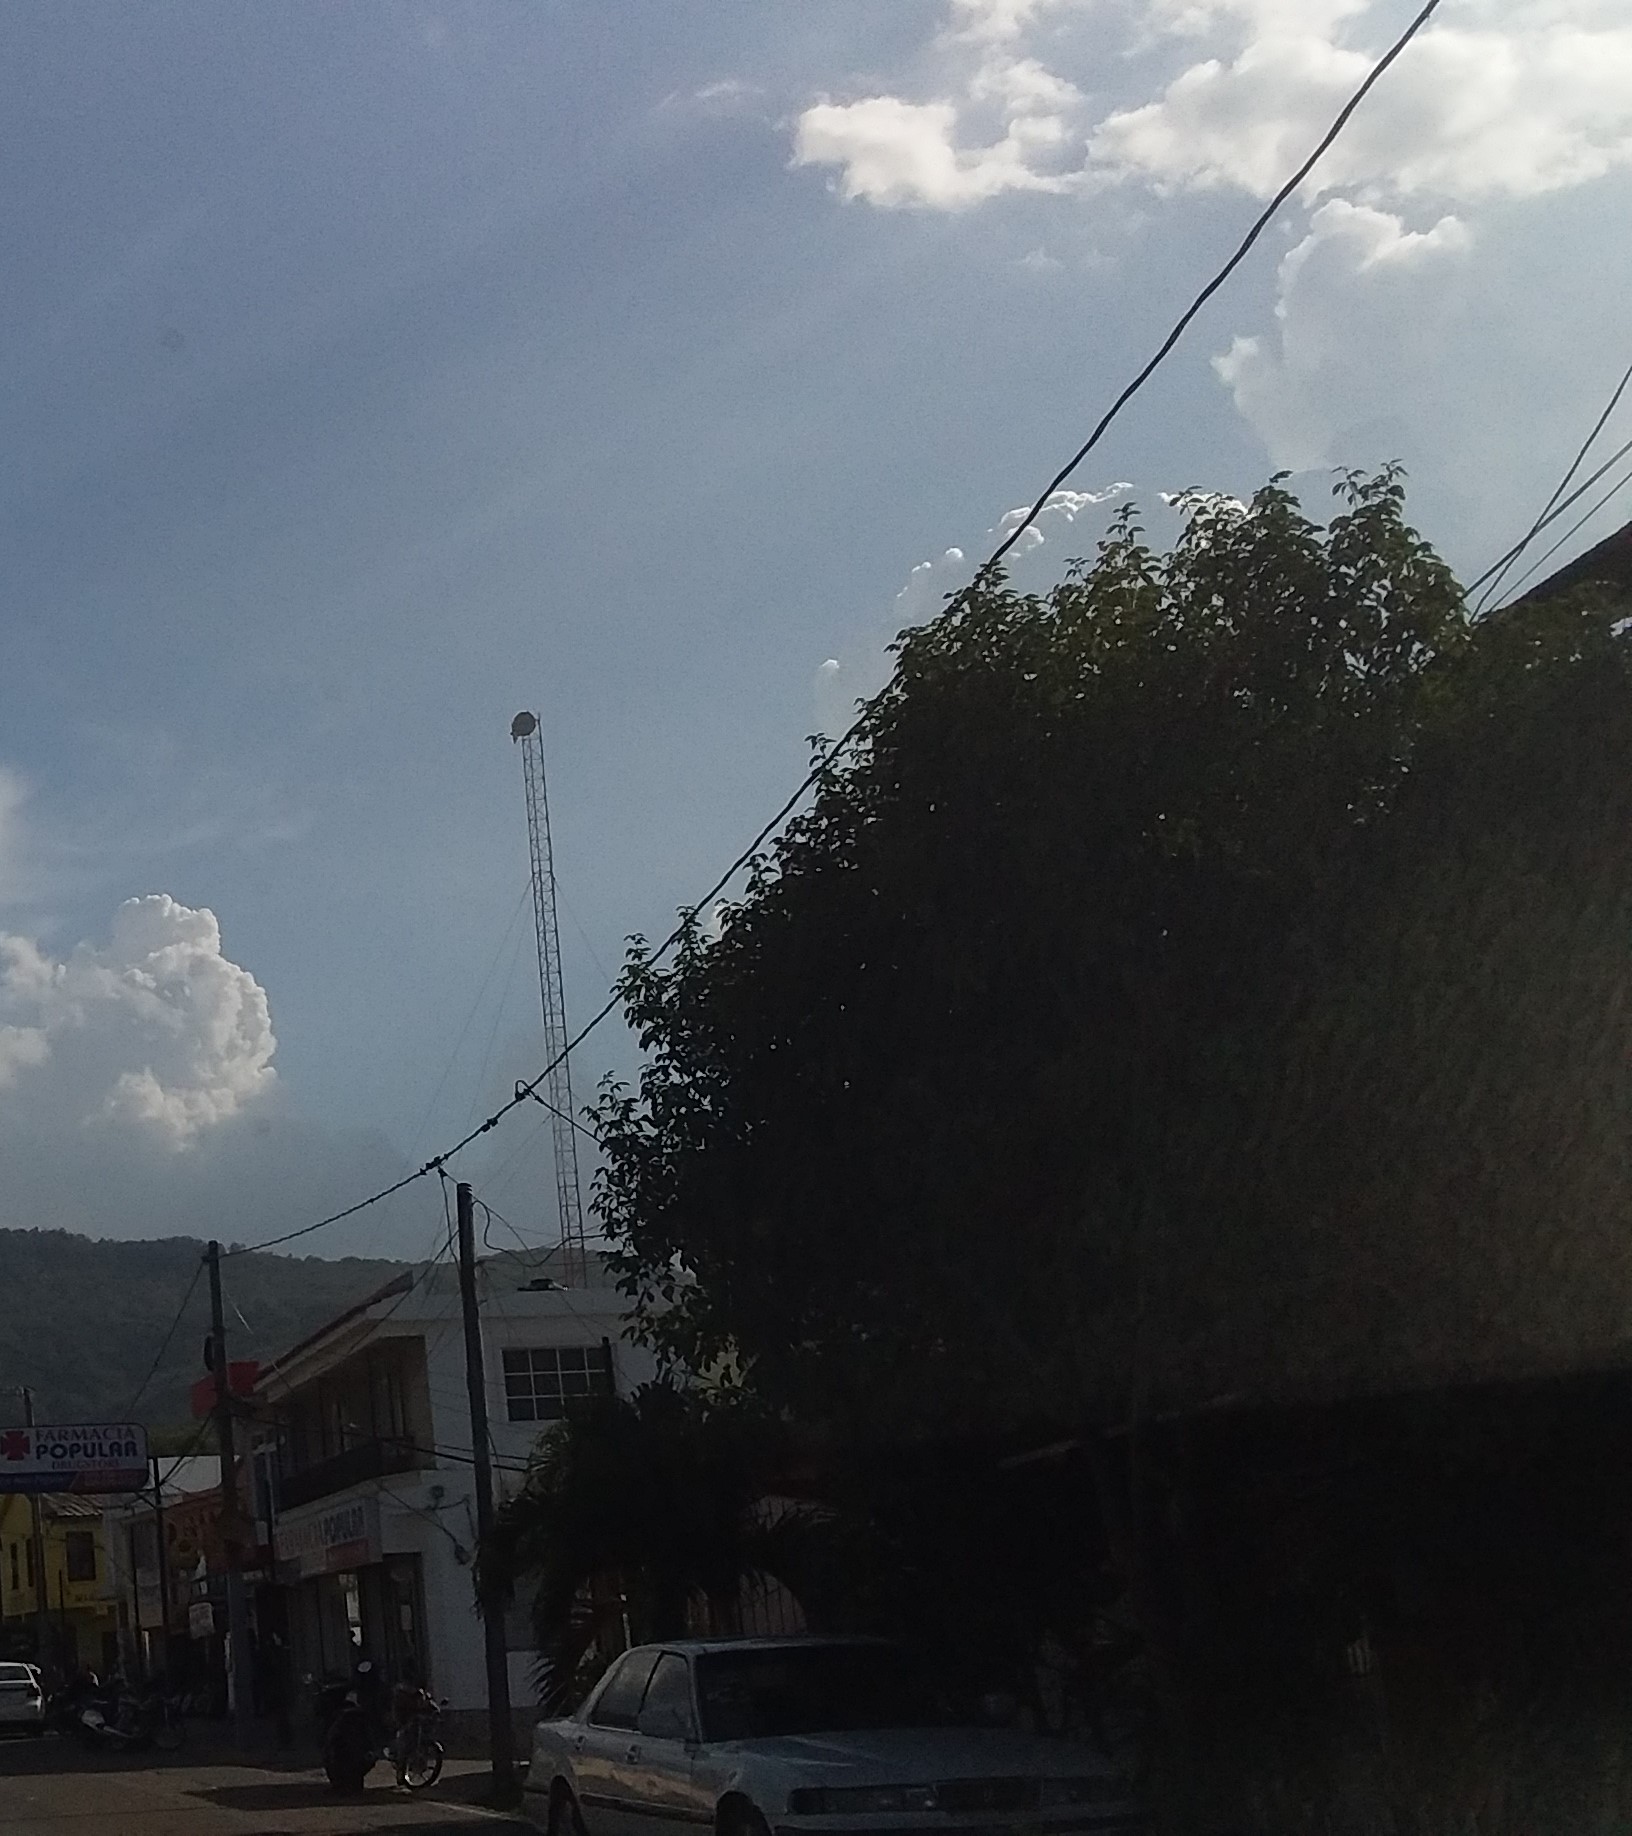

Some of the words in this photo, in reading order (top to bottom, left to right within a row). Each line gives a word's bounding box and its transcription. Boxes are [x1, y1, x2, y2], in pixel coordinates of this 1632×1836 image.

[36, 1427, 136, 1442] FARMACIA
[36, 1441, 138, 1460] POPULAR
[322, 1506, 365, 1546] POPULAR
